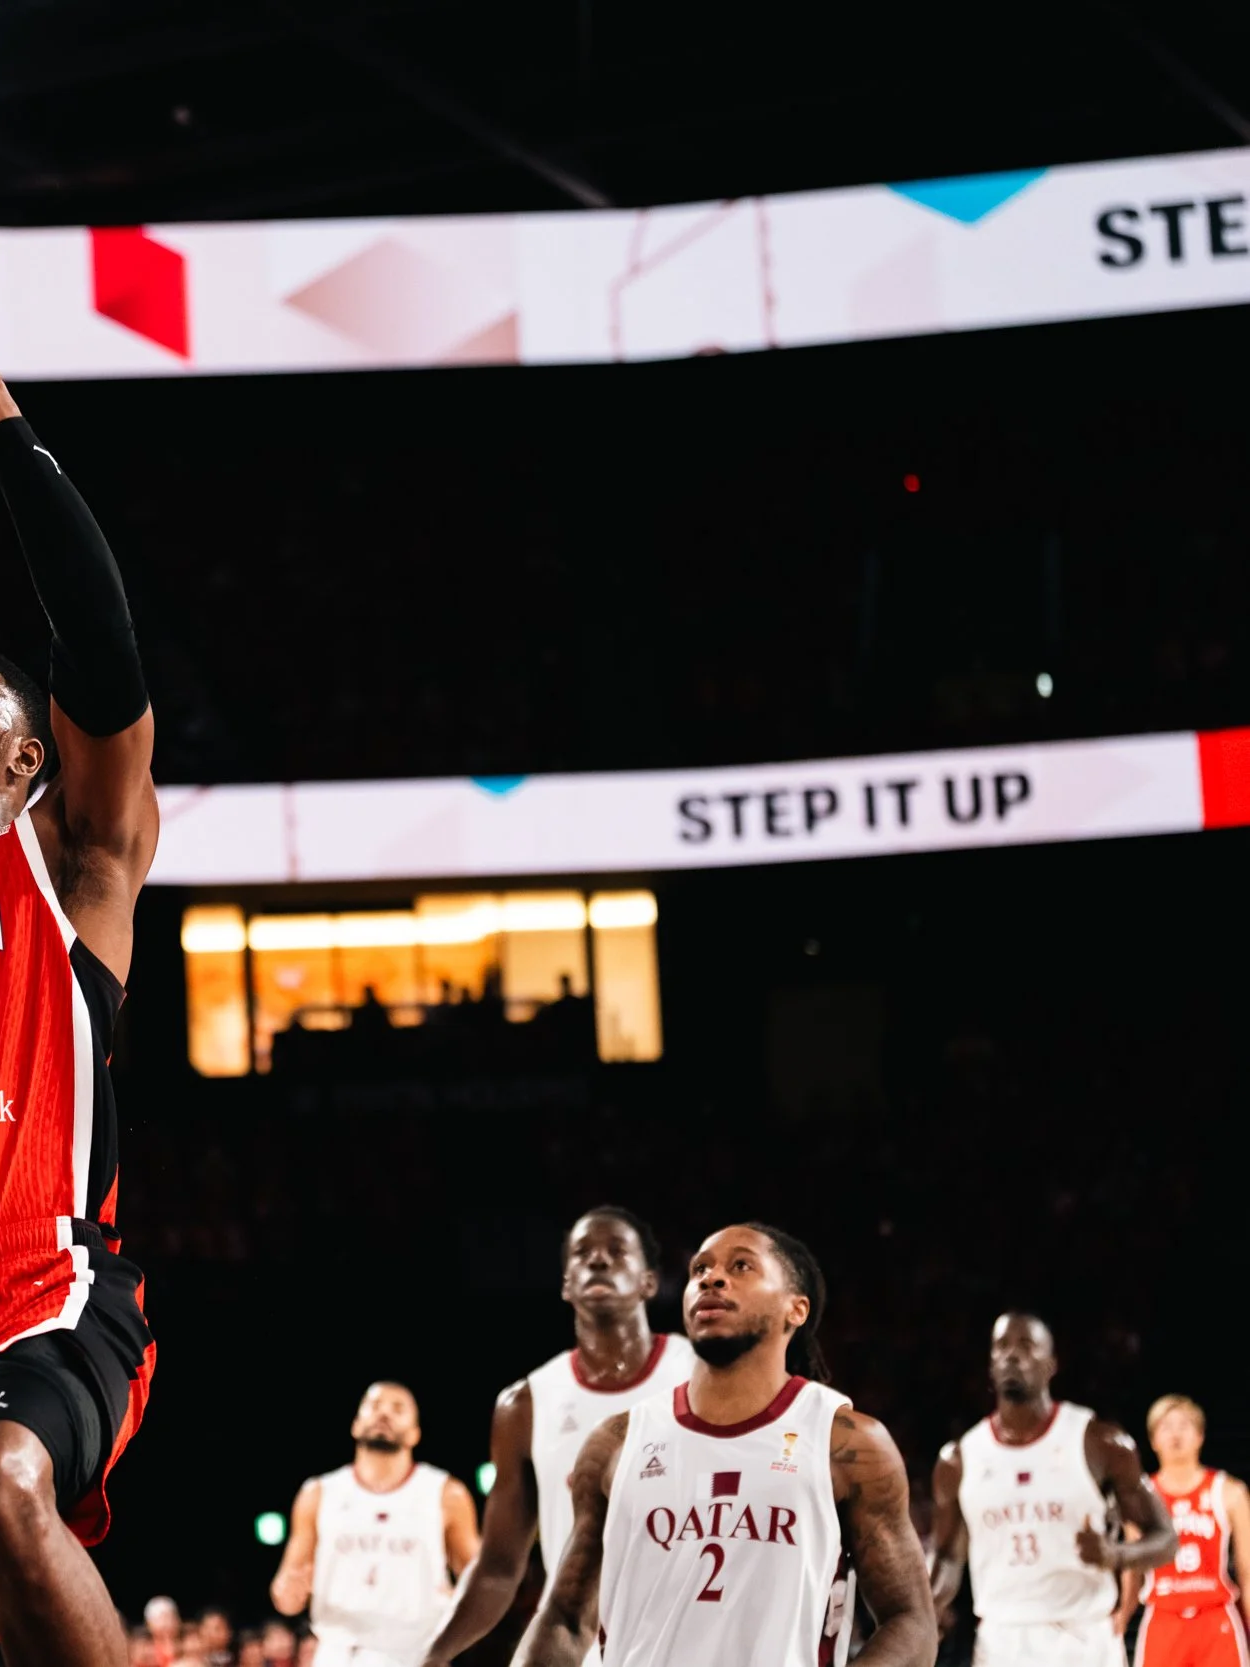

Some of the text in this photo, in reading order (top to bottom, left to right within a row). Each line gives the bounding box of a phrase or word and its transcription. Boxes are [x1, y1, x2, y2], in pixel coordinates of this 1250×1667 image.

[678, 770, 1032, 844] STEP IT UP
[646, 1502, 797, 1551] QATAR
[982, 1502, 1065, 1531] QATAR
[696, 1543, 725, 1602] 2
[1009, 1532, 1041, 1566] 33
